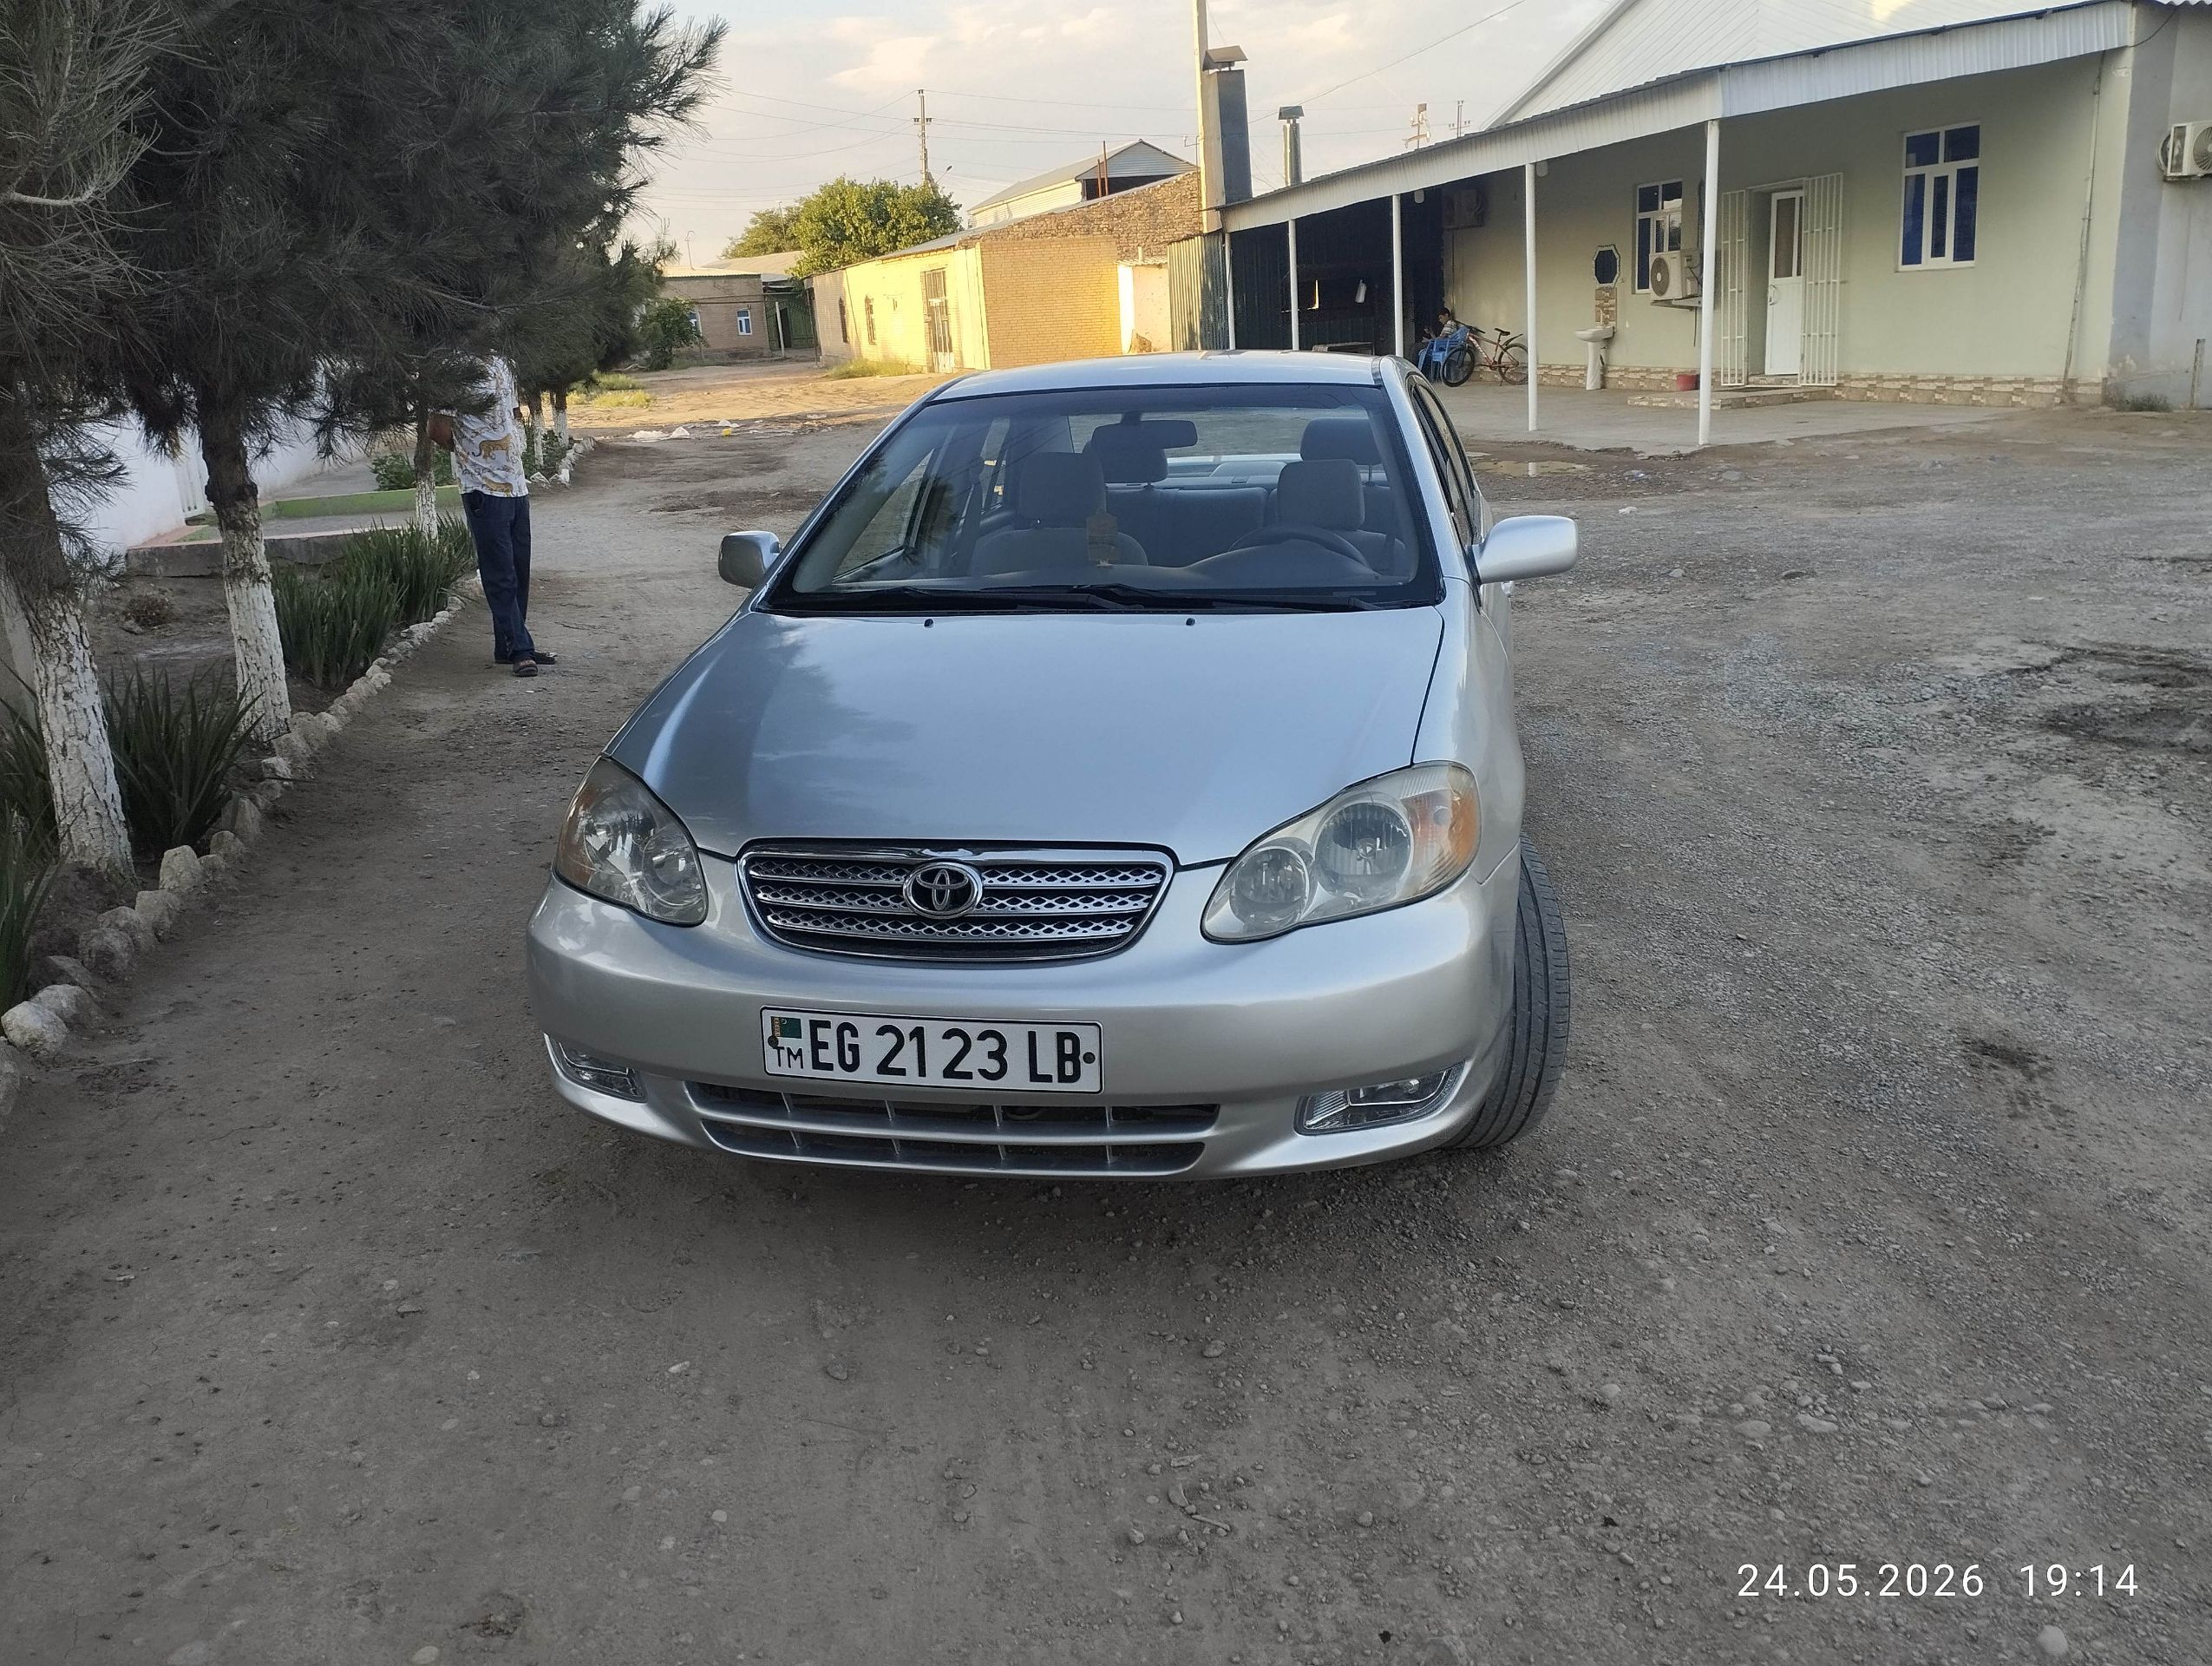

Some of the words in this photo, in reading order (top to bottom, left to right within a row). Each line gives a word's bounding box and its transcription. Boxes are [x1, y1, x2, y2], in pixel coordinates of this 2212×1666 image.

[773, 1046, 804, 1070] TM
[808, 1019, 861, 1074] EG
[1027, 1030, 1082, 1084] LB
